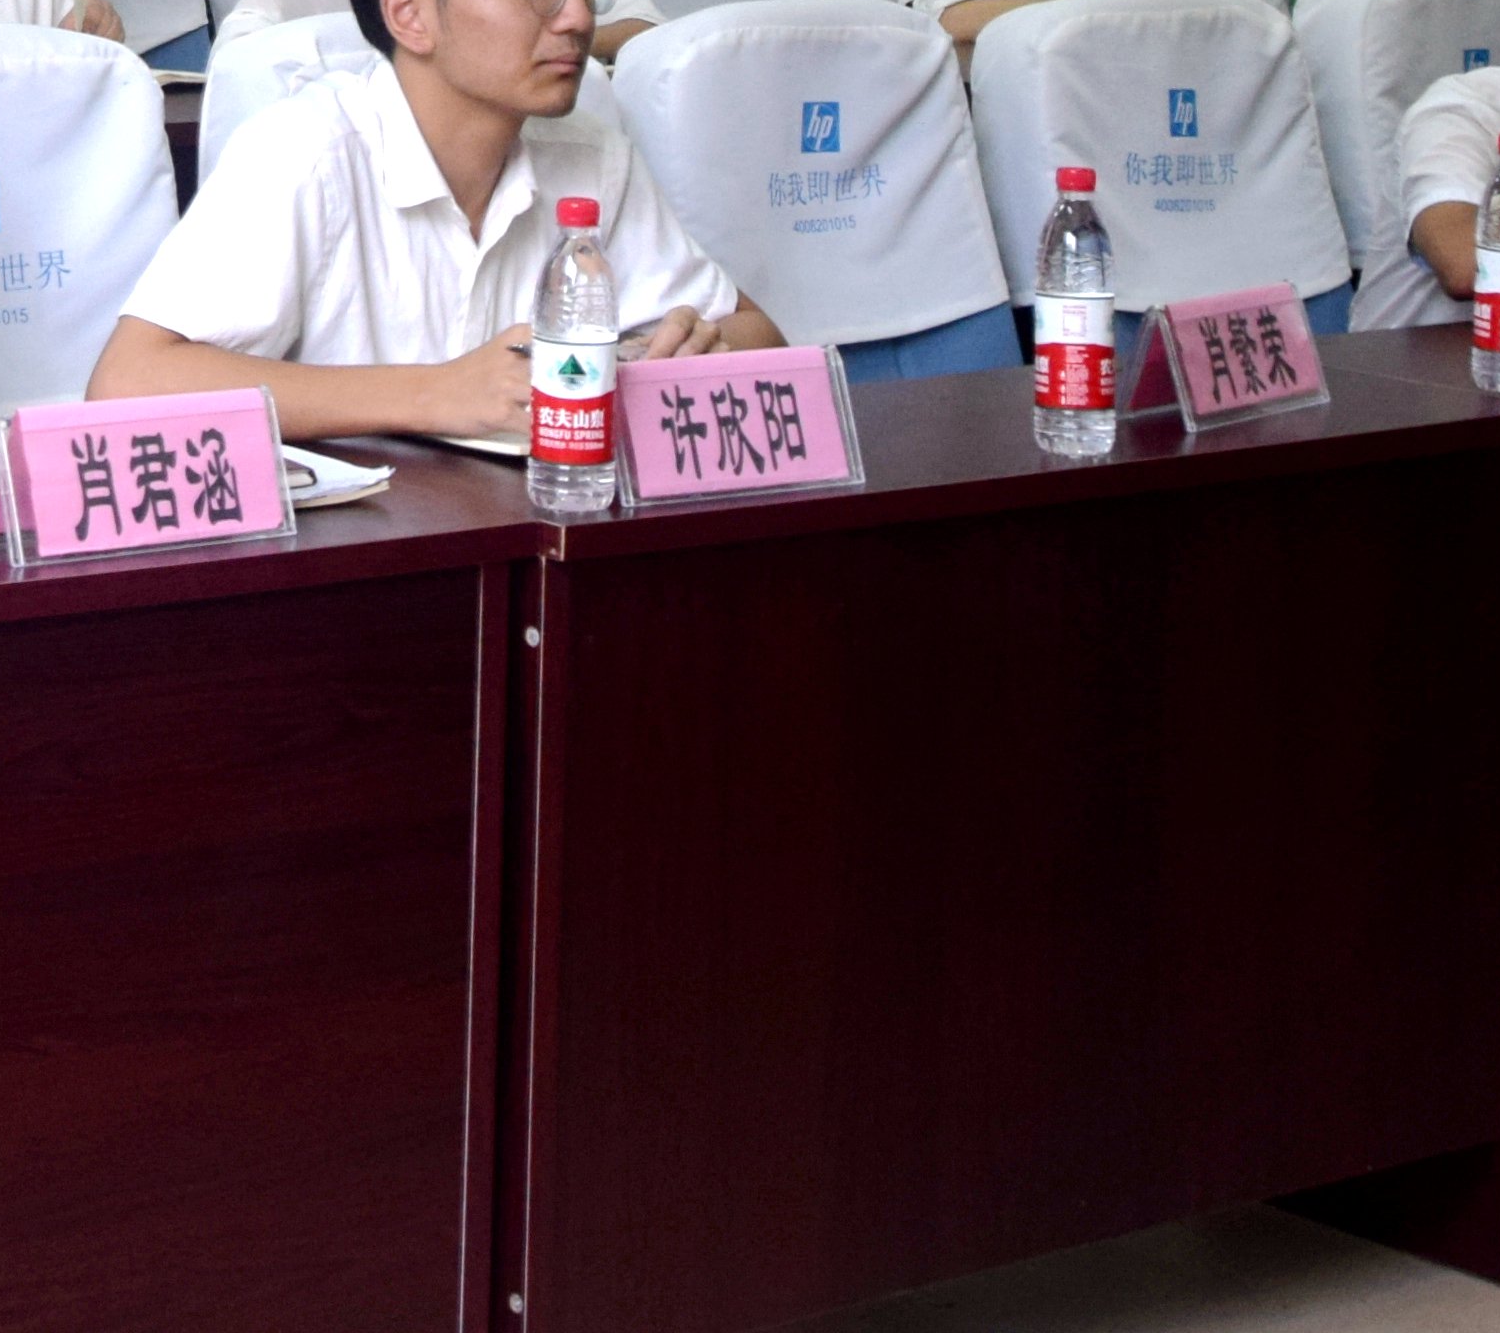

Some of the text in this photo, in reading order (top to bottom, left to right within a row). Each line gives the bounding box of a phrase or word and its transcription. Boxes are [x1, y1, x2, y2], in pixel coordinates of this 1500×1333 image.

[805, 103, 836, 151] hp
[1172, 91, 1195, 136] hp
[768, 164, 887, 208] 你我即世界
[1125, 152, 1238, 187] 你我即世界
[539, 406, 605, 429] 农夫山泉
[660, 379, 807, 480] 许欣阳
[72, 427, 243, 542] 肖君涵
